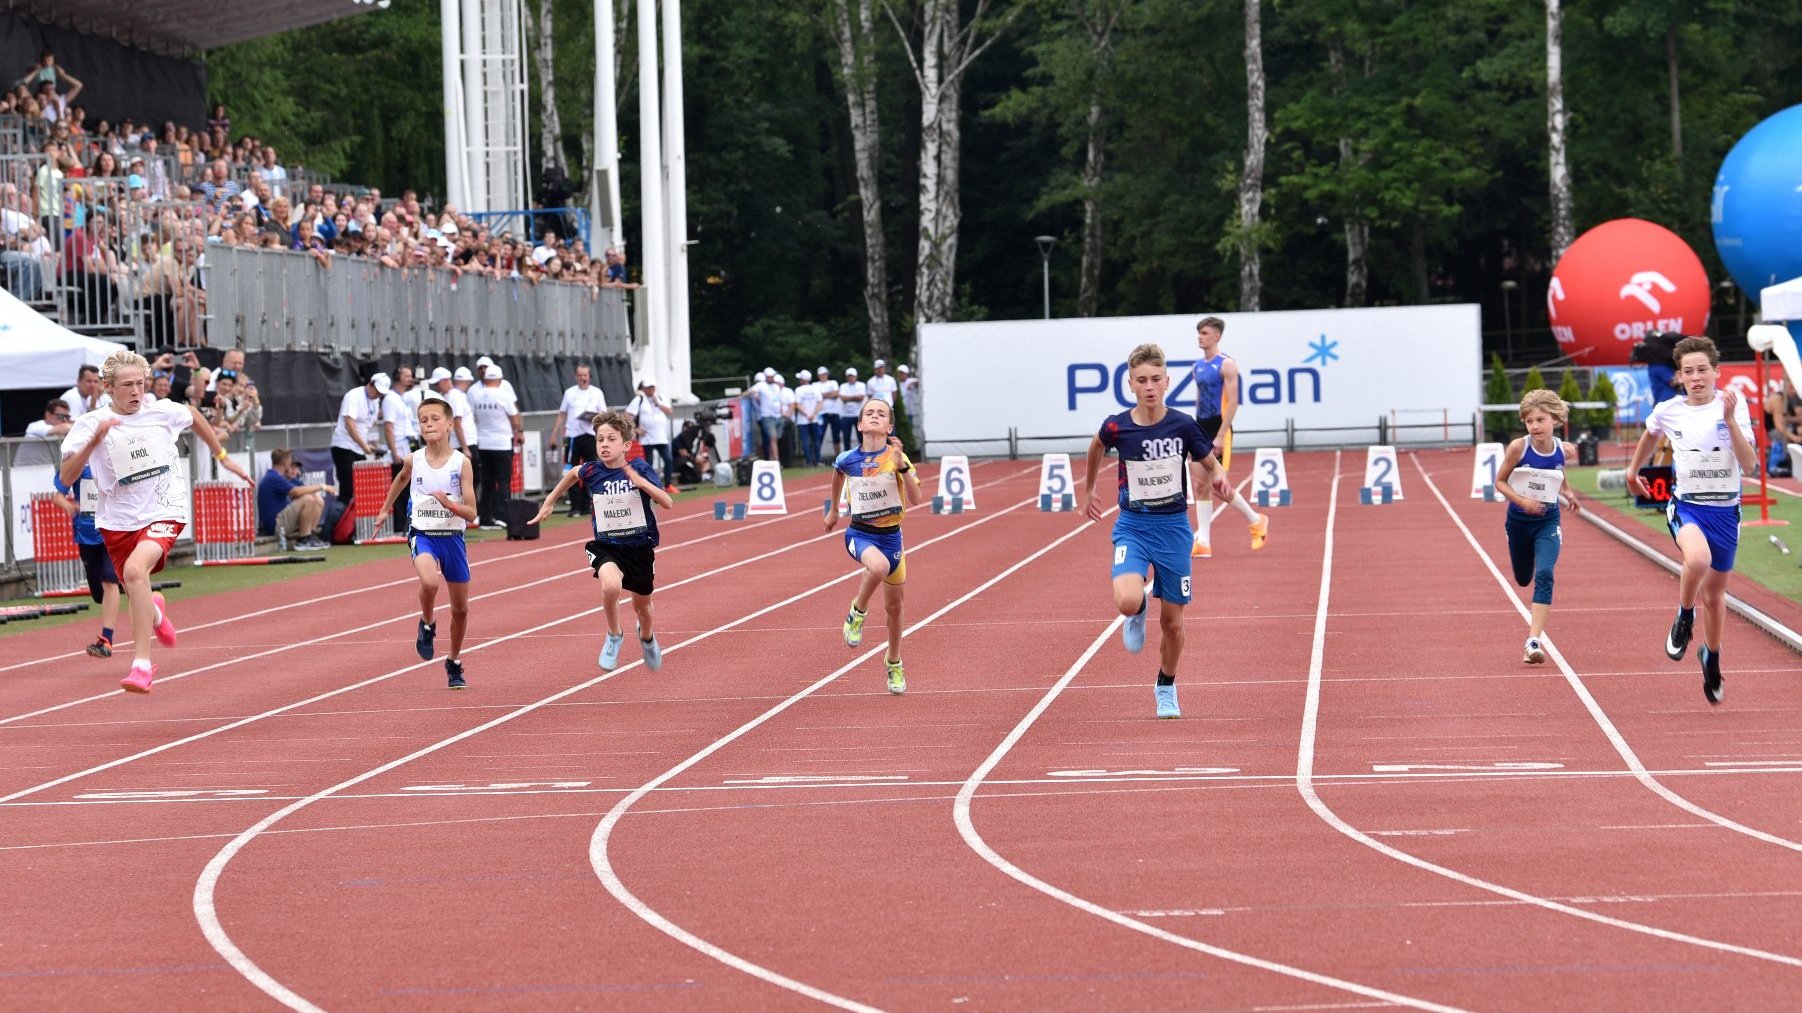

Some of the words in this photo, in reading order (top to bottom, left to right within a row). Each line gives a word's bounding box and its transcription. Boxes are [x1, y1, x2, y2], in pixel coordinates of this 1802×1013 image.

[1613, 317, 1683, 341] ORLEN
[1067, 359, 1321, 411] PZan
[130, 446, 150, 461] KRÓL
[1141, 436, 1184, 461] 3030
[944, 465, 966, 497] 6
[1046, 463, 1068, 495] 5
[1137, 473, 1174, 487] MAJEWSKI
[1259, 458, 1280, 489] 3
[1371, 456, 1394, 487] 2
[1482, 453, 1497, 488] 1
[87, 492, 98, 502] BAS
[756, 471, 777, 502] 8
[858, 489, 888, 502] ZIELONKA
[603, 507, 633, 519] MAŁECKI
[150, 523, 174, 535] NIKE
[1183, 579, 1190, 593] 3
